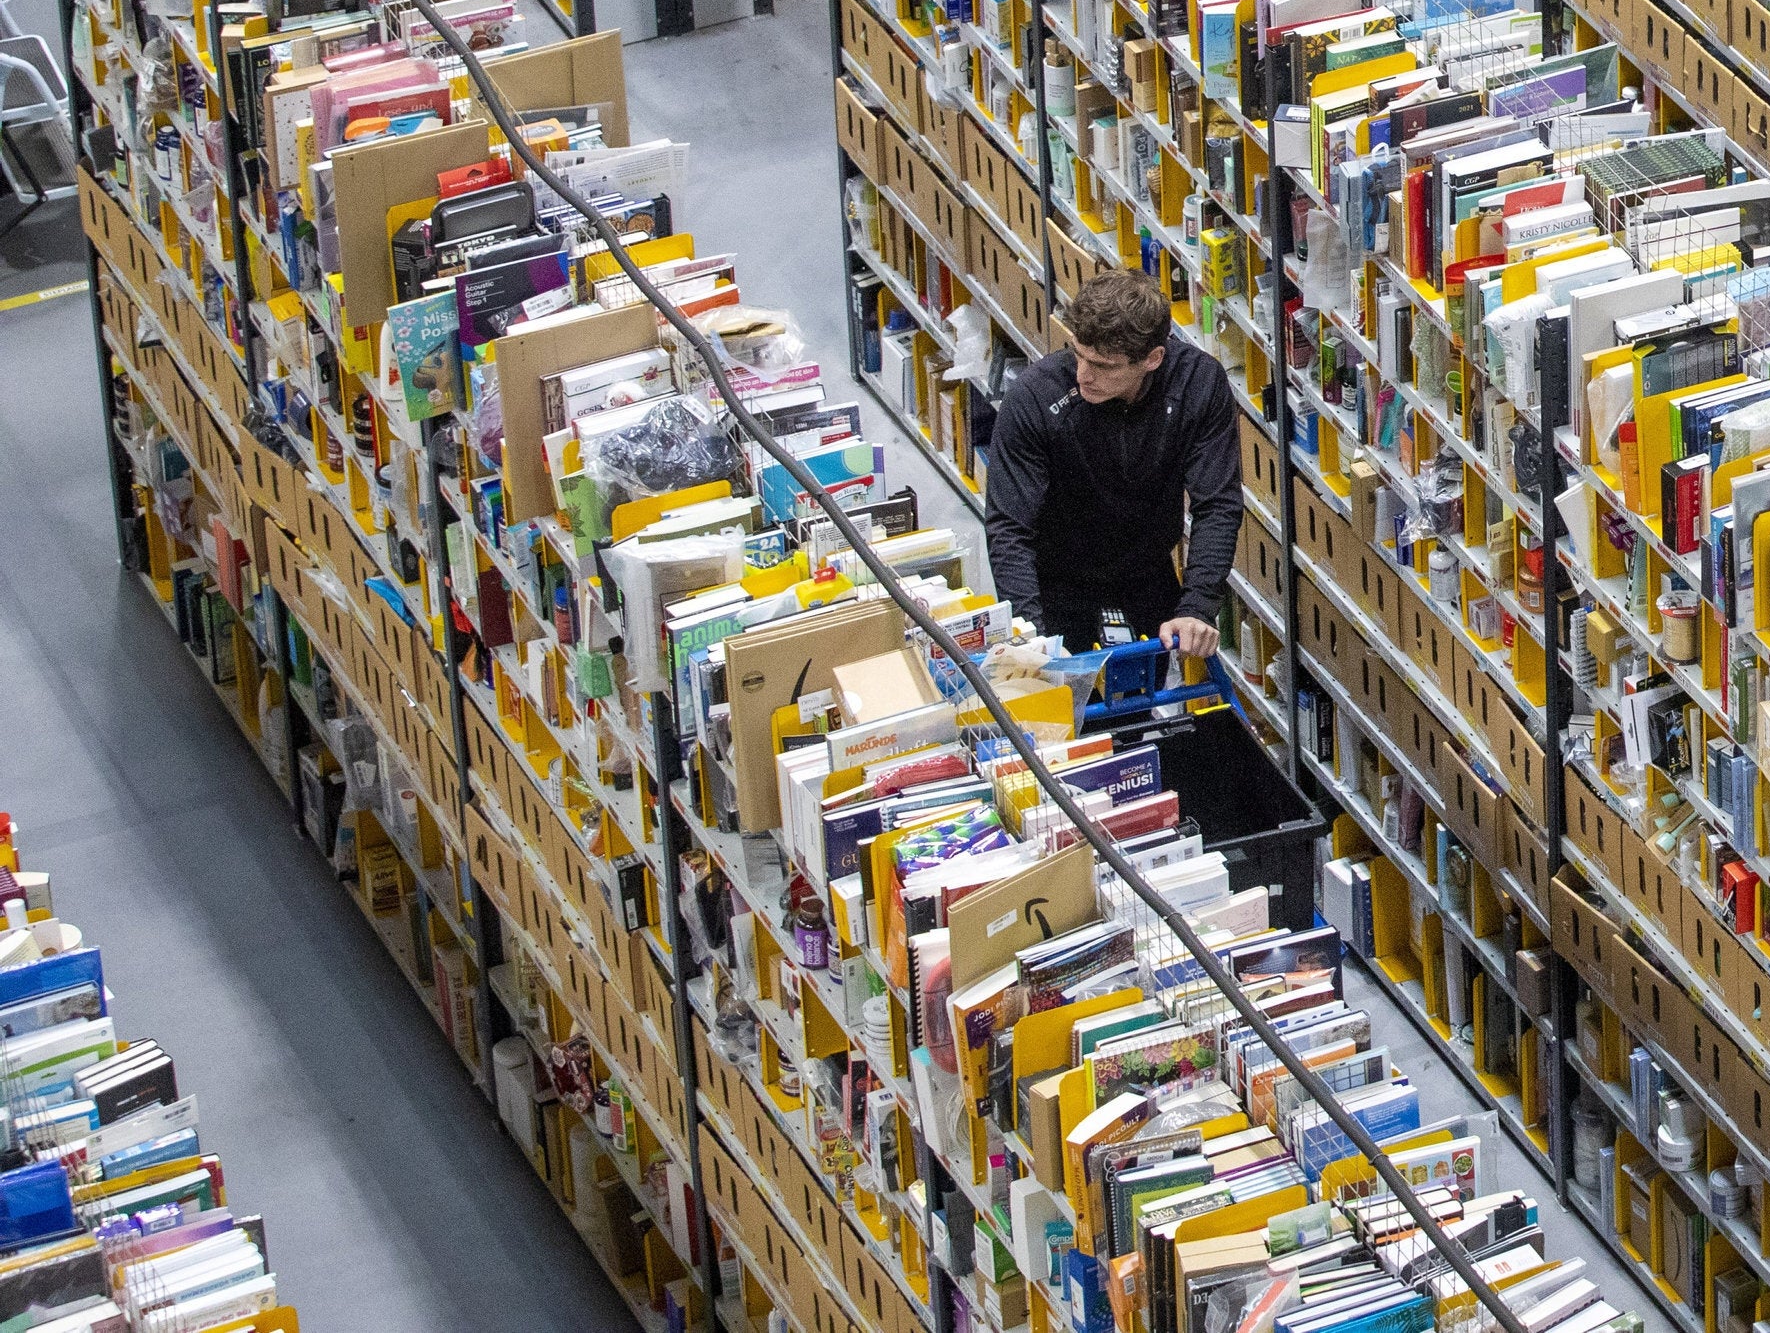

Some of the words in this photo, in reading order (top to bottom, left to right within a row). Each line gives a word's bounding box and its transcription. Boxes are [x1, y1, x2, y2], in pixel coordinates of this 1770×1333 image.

[1458, 104, 1474, 113] 2021
[1464, 176, 1480, 186] CGP
[1519, 223, 1551, 239] KRISTY
[1553, 214, 1594, 233] NICOLLE
[457, 235, 495, 249] TOKYO
[464, 279, 495, 292] Acoustic
[423, 310, 456, 325] Miss
[761, 538, 780, 550] 2A
[845, 733, 898, 757] MARUNDE
[1120, 764, 1144, 776] BECOME
[812, 935, 821, 964] balance
[1108, 1115, 1141, 1140] PICOULT
